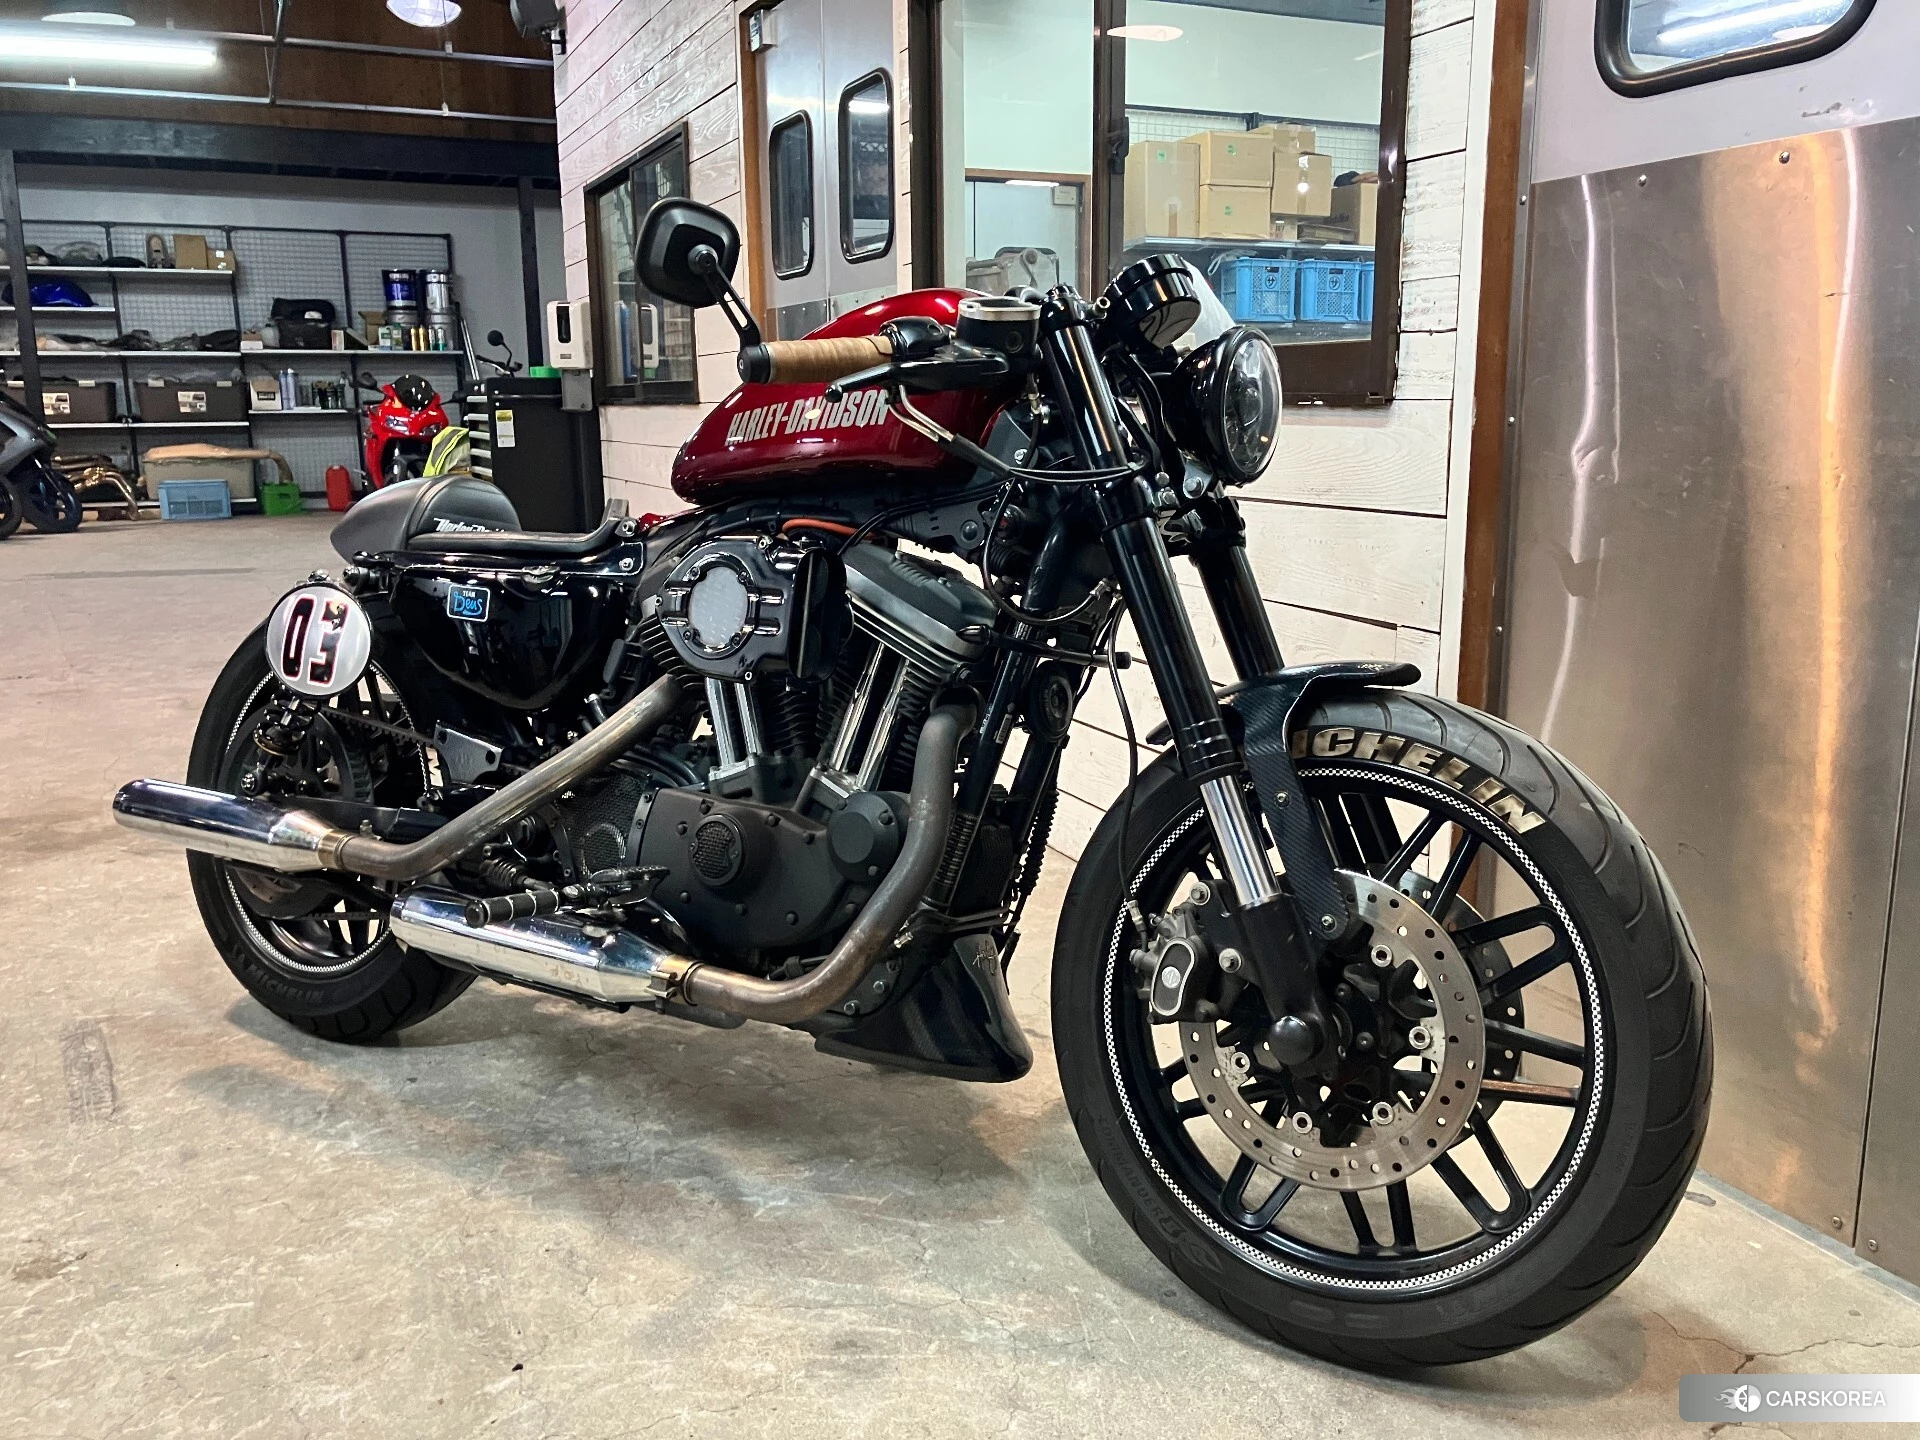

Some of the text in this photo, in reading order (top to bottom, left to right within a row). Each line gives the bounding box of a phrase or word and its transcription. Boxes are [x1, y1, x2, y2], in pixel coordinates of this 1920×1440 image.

[724, 389, 890, 446] HARLEY-DAVIDSON
[453, 591, 483, 615] Deus
[462, 590, 476, 598] TEAM
[281, 595, 349, 686] 03
[1292, 728, 1546, 834] ICHELIN
